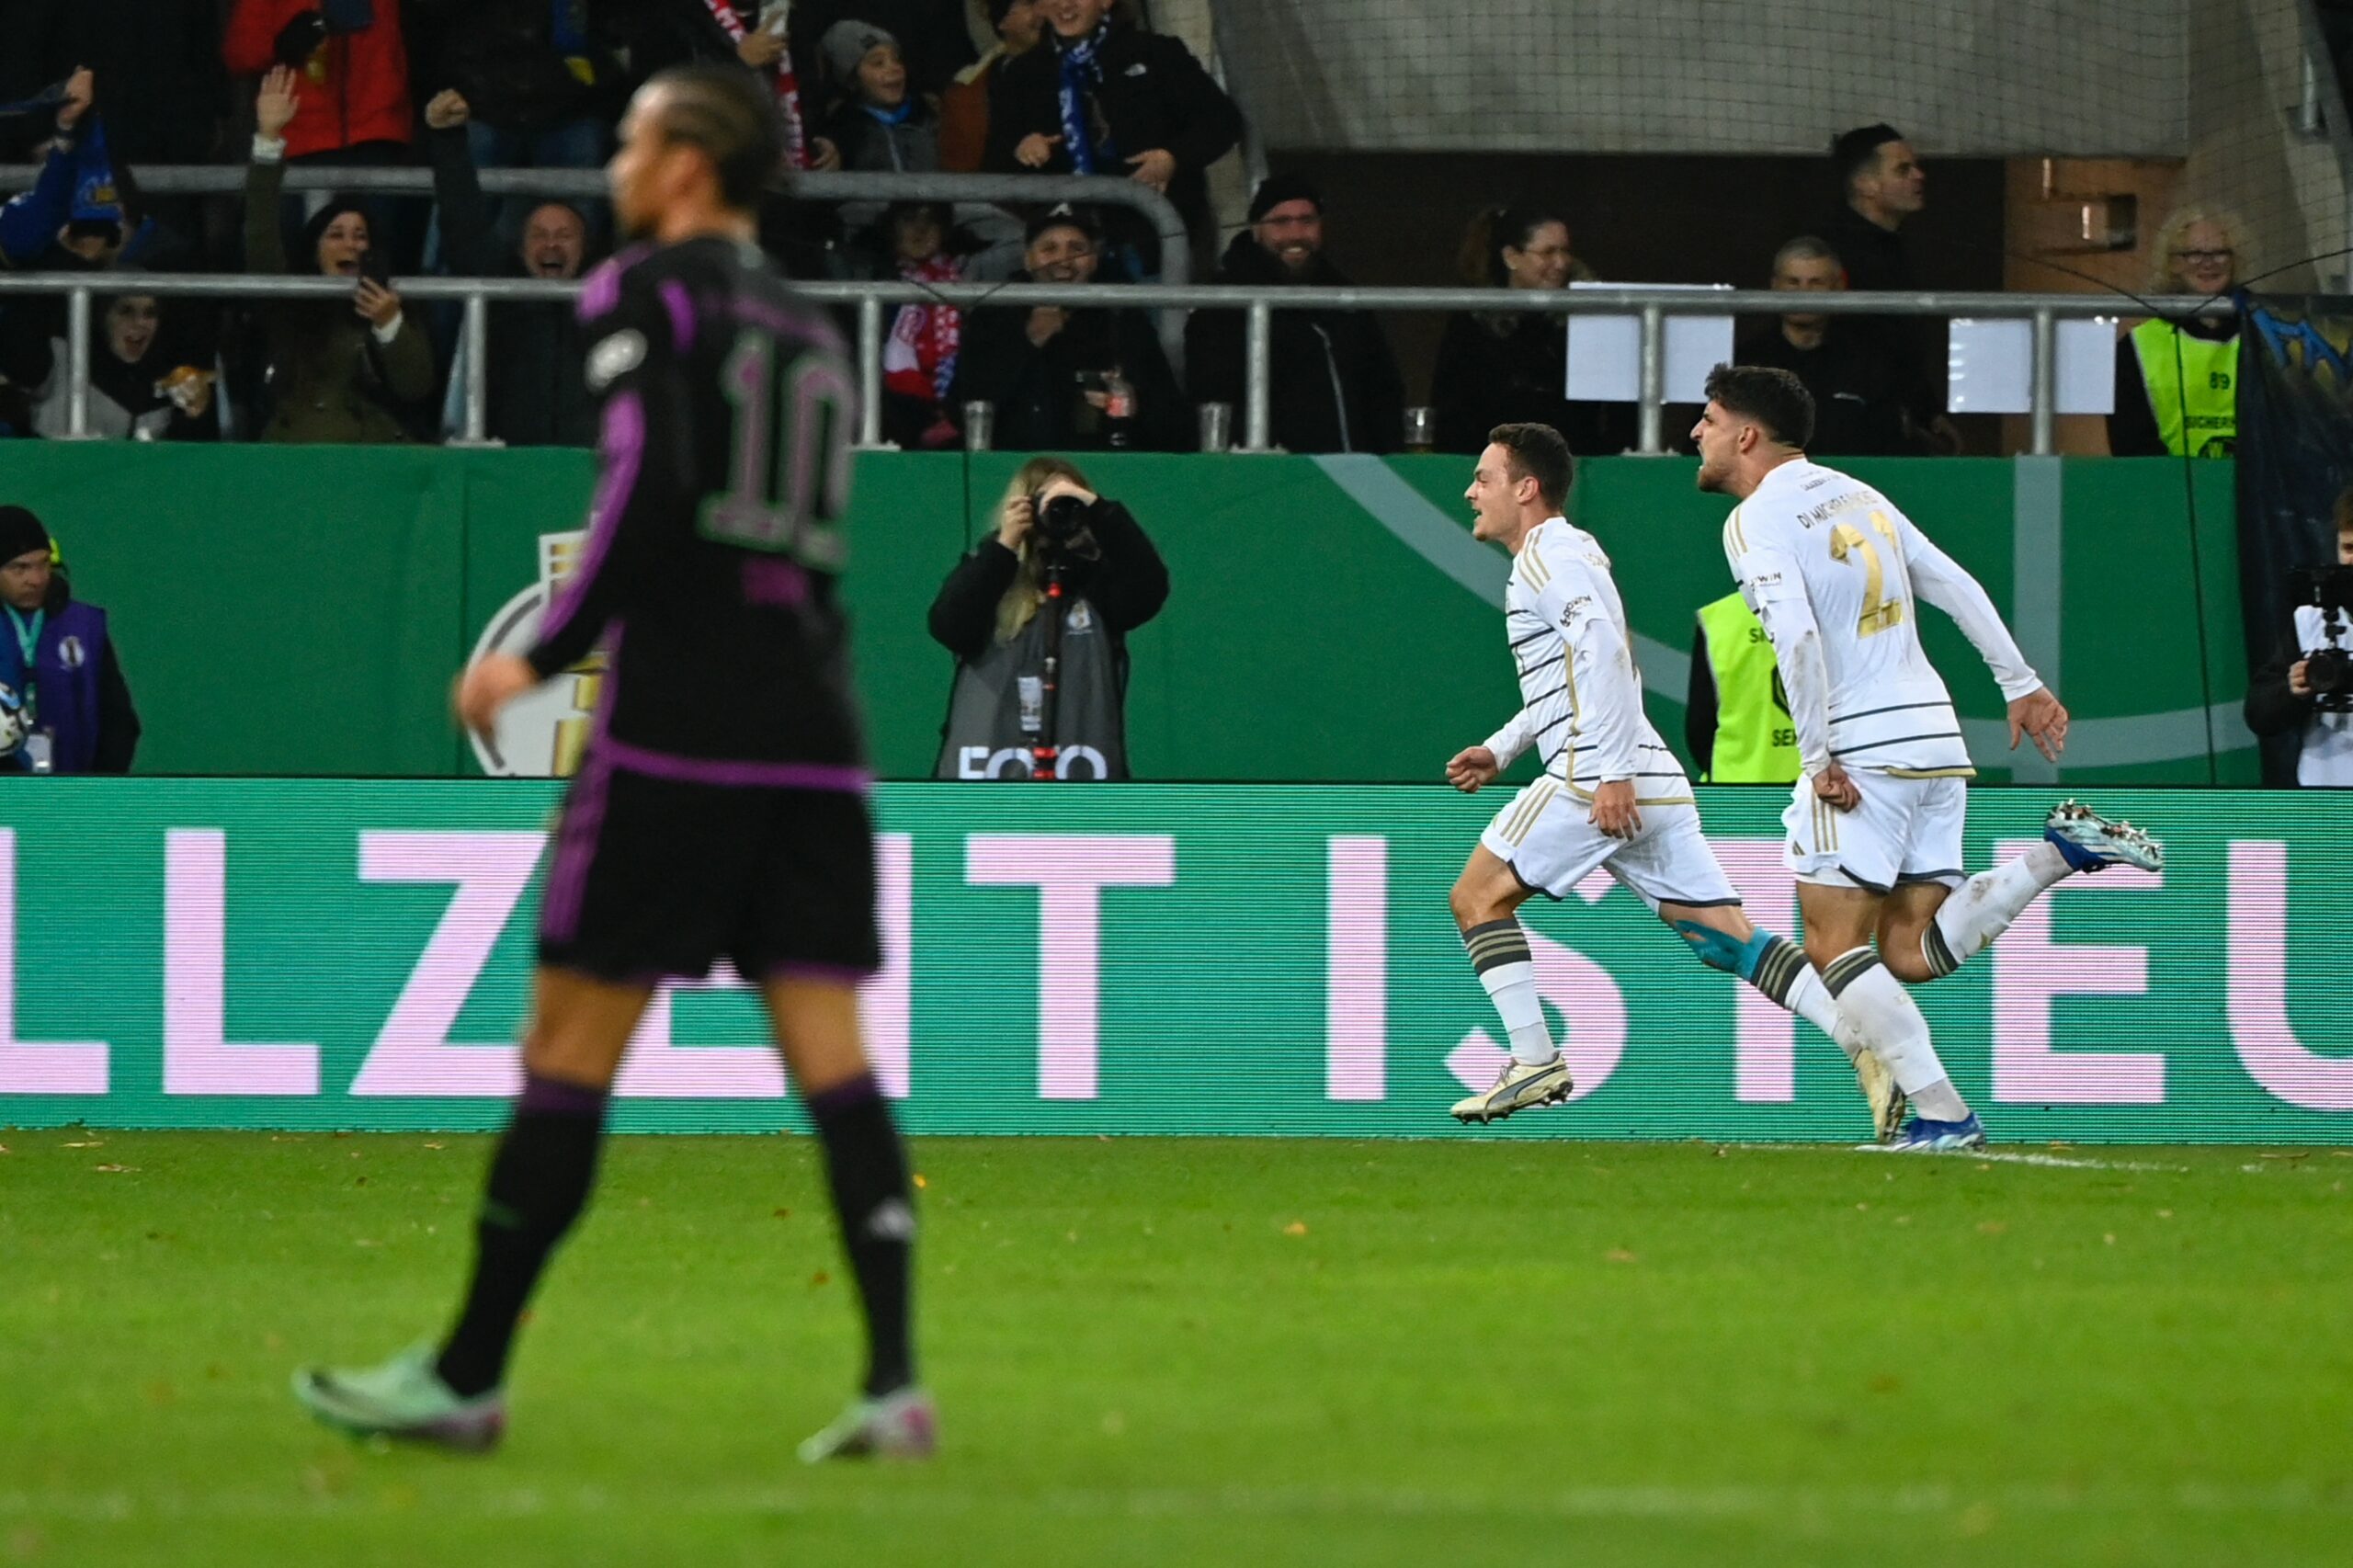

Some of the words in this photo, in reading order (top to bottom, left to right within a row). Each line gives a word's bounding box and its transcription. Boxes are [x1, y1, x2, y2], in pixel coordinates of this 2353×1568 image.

[2209, 371, 2231, 391] 89
[696, 329, 862, 574] 10
[1829, 510, 1903, 639] 21
